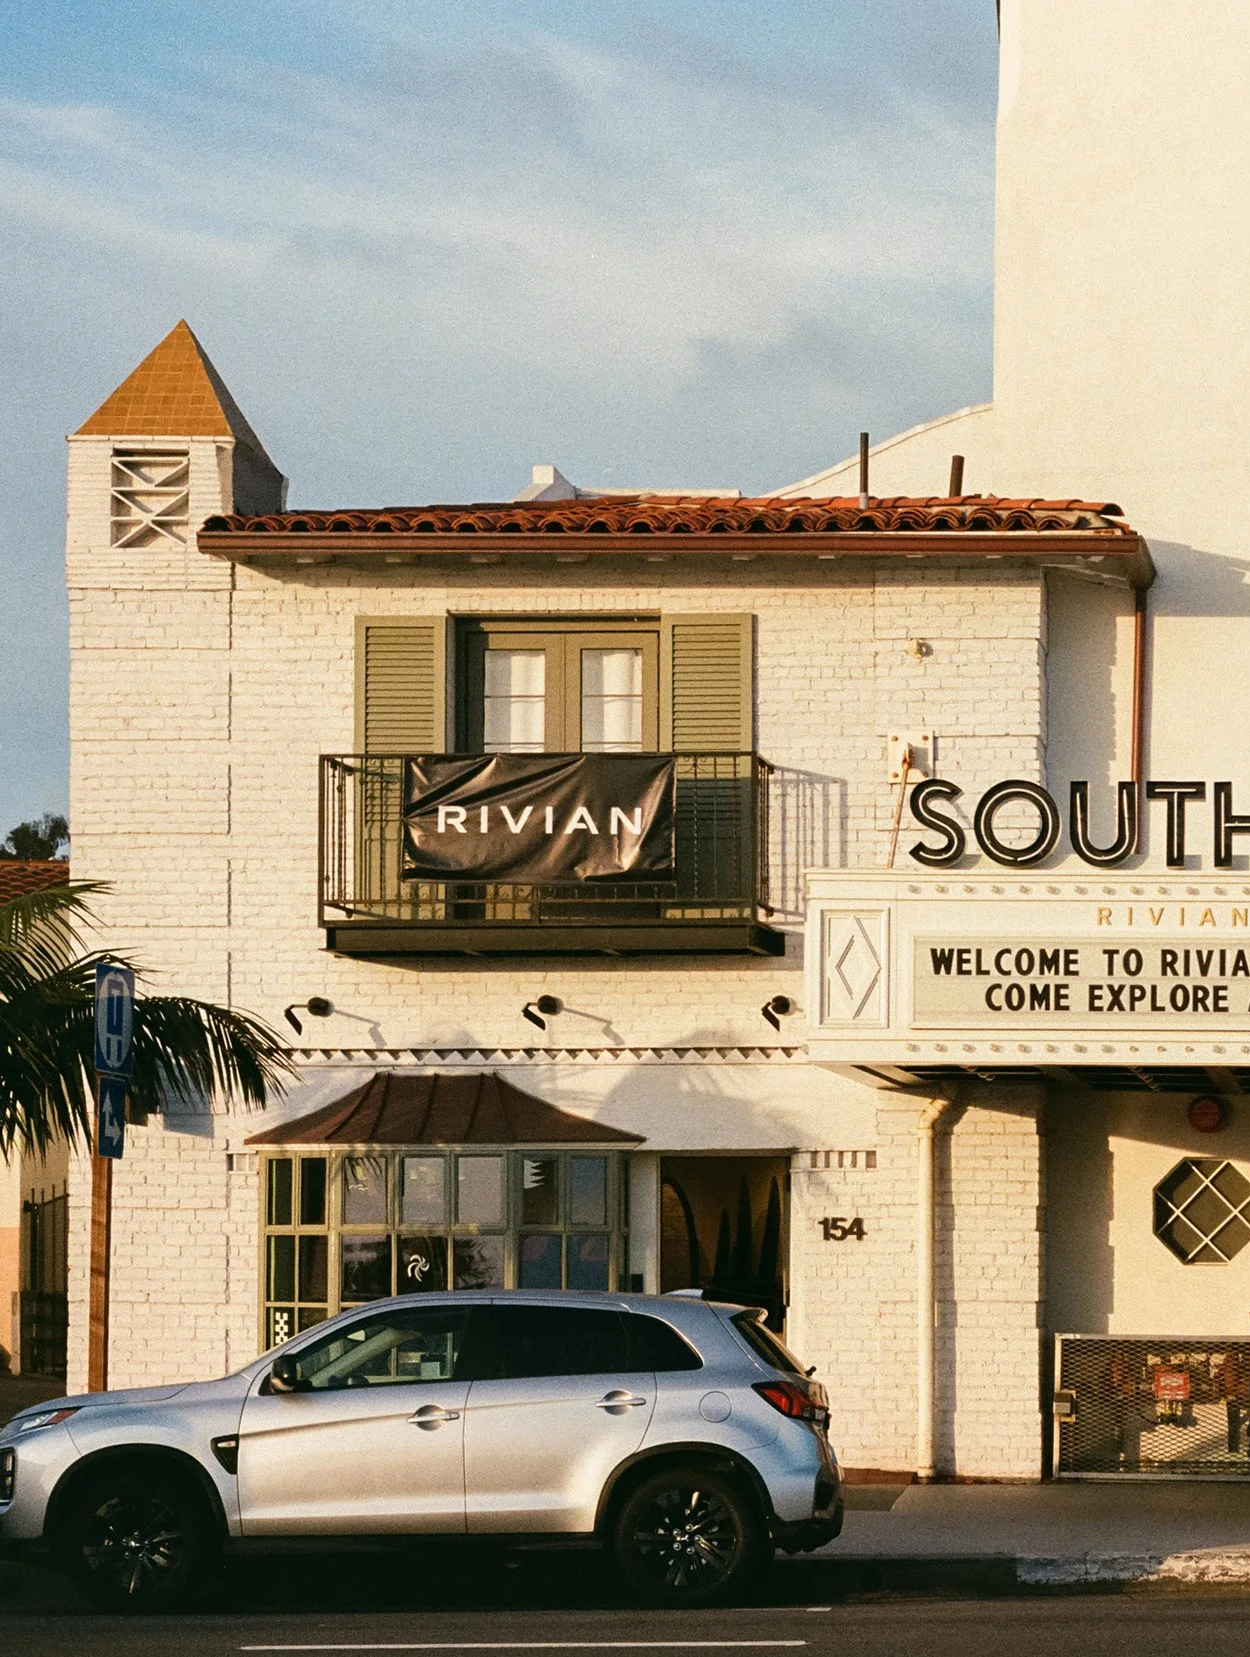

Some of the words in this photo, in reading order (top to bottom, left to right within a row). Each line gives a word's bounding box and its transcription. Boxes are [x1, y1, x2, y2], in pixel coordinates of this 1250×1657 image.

[437, 805, 642, 835] RIVIAN
[1097, 907, 1250, 927] RIVIAN
[930, 948, 1080, 976] WELCOME
[1103, 948, 1144, 977] TO
[985, 983, 1070, 1012] COME
[1088, 984, 1229, 1013] EXPLORE
[818, 1217, 868, 1241] 154
